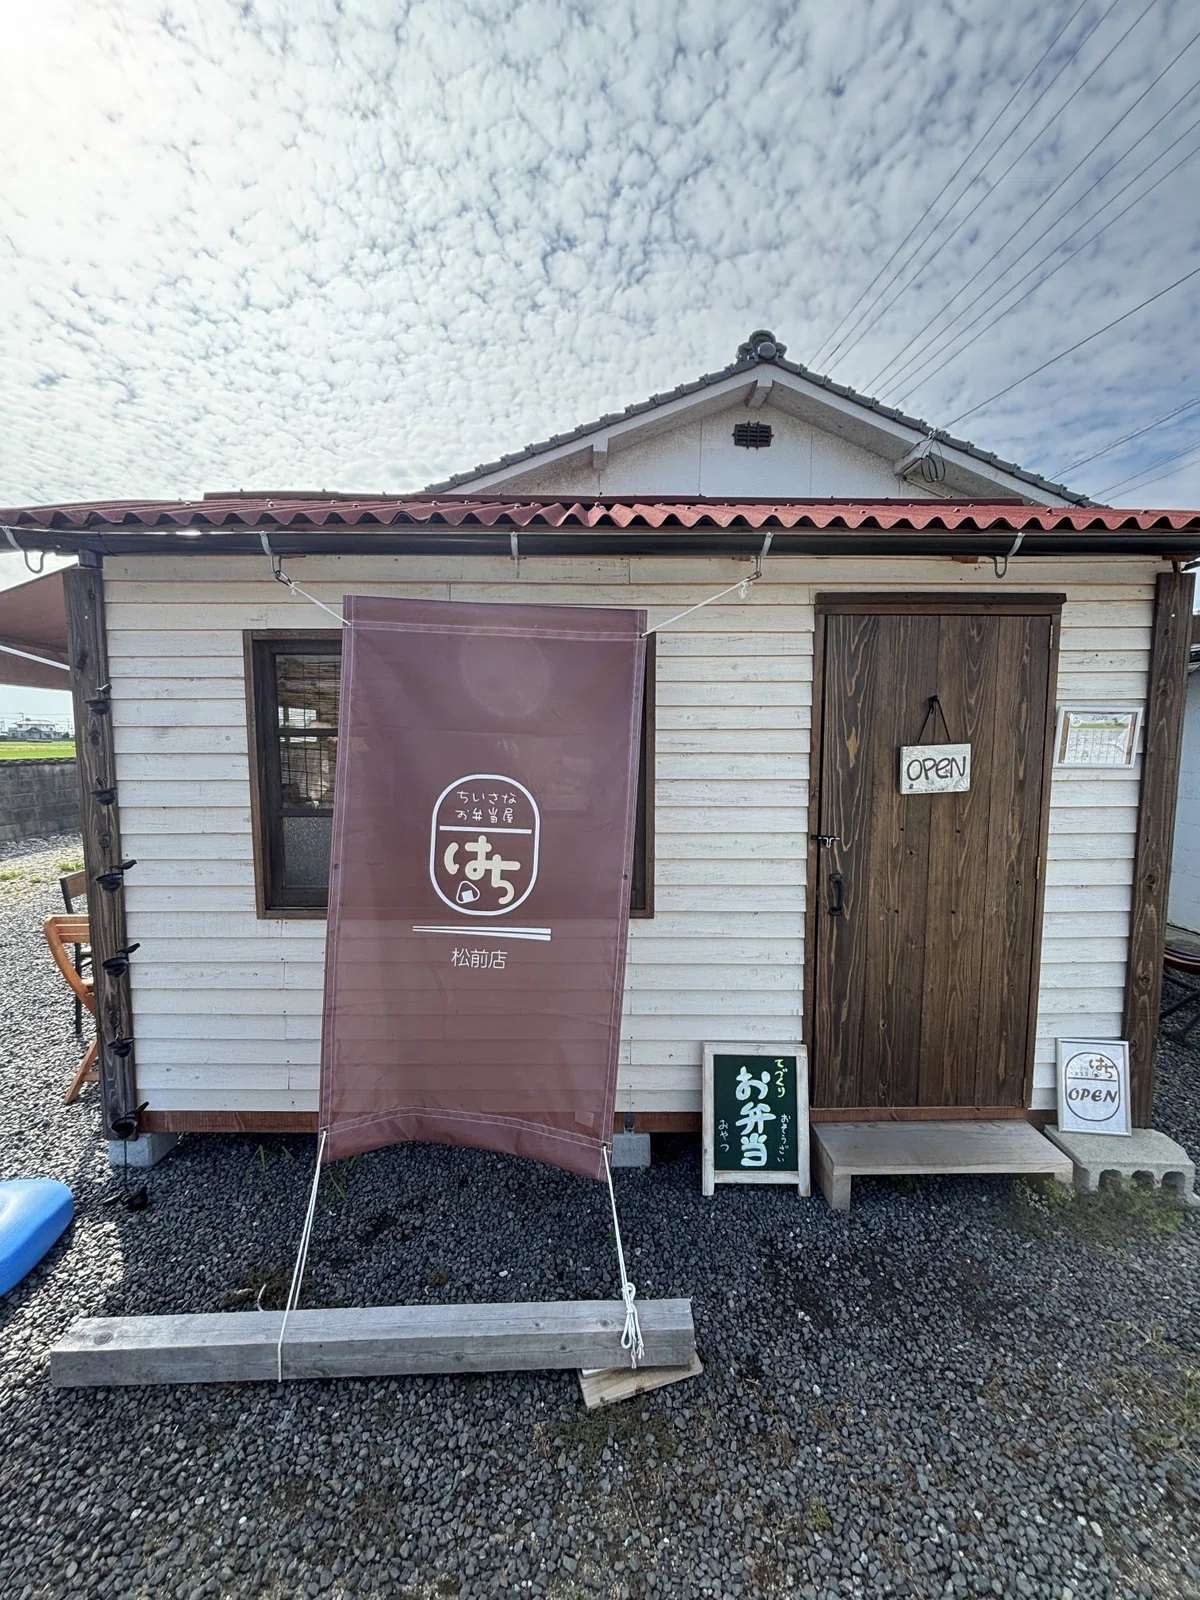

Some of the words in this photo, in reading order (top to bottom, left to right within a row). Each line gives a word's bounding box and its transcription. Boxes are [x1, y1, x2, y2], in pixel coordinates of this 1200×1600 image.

[456, 790, 517, 804] ちいさな
[455, 806, 514, 823] お弁当屋
[444, 835, 521, 905] はち
[451, 947, 508, 969] 松前店
[774, 1058, 788, 1098] てづくり
[1088, 1057, 1115, 1079] はち
[735, 1066, 777, 1167] お弁当
[718, 1119, 730, 1152] おやつ
[776, 1113, 792, 1162] おそうざい
